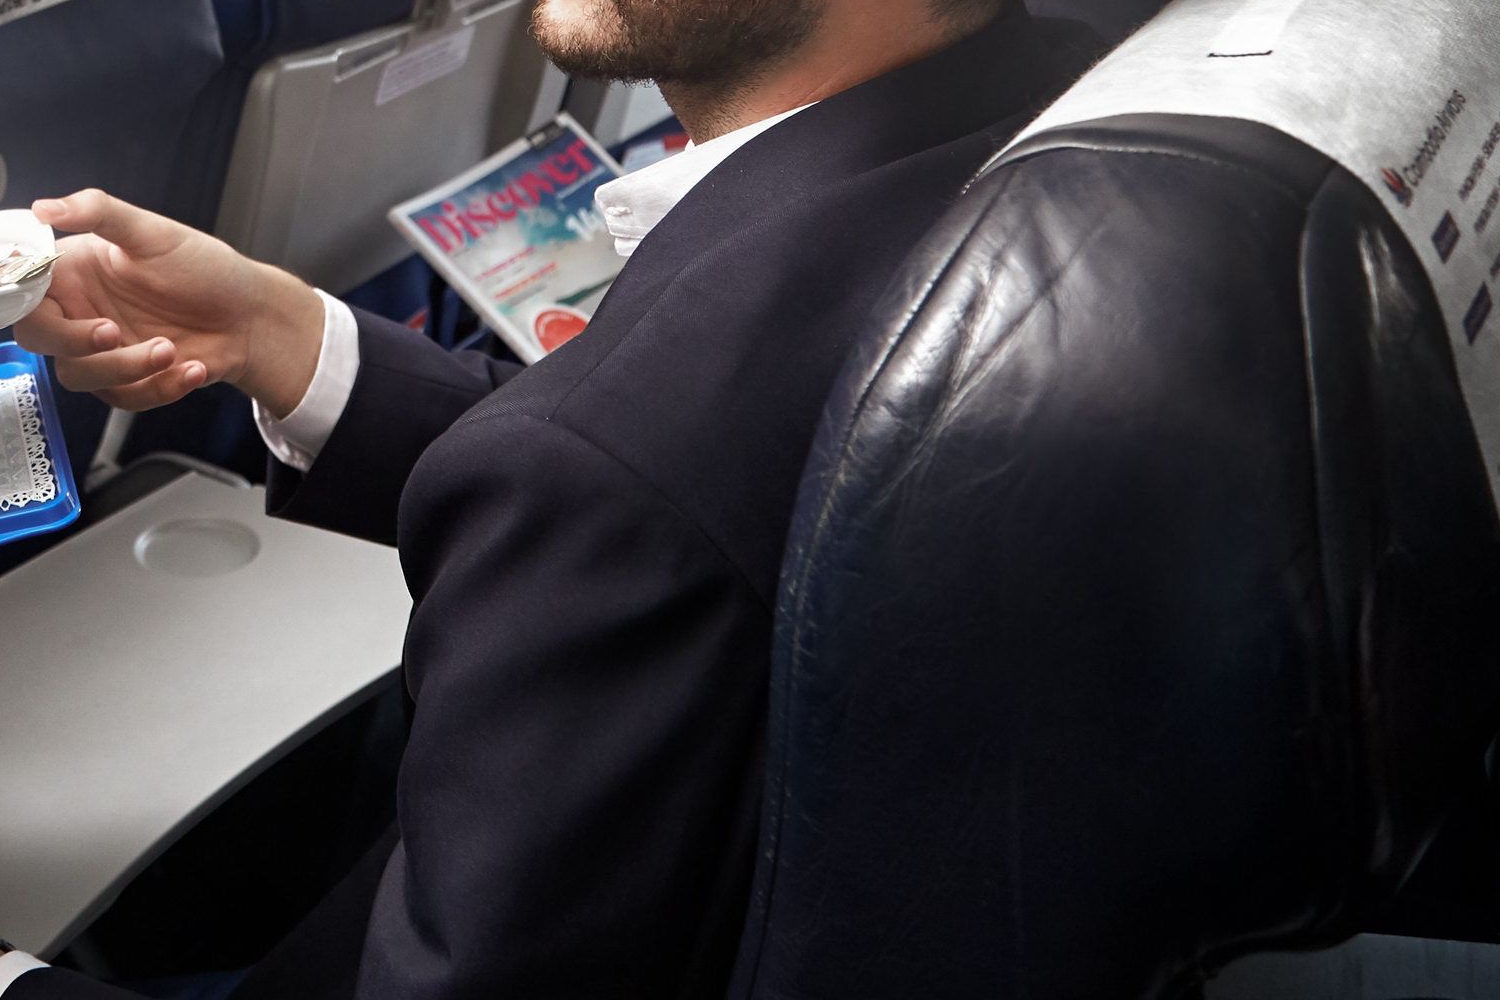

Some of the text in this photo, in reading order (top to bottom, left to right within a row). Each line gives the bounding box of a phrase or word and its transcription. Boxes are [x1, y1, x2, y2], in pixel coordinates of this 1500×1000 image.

[1402, 126, 1447, 187] Cambodia
[1434, 89, 1467, 134] Airways
[417, 136, 595, 253] Discover
